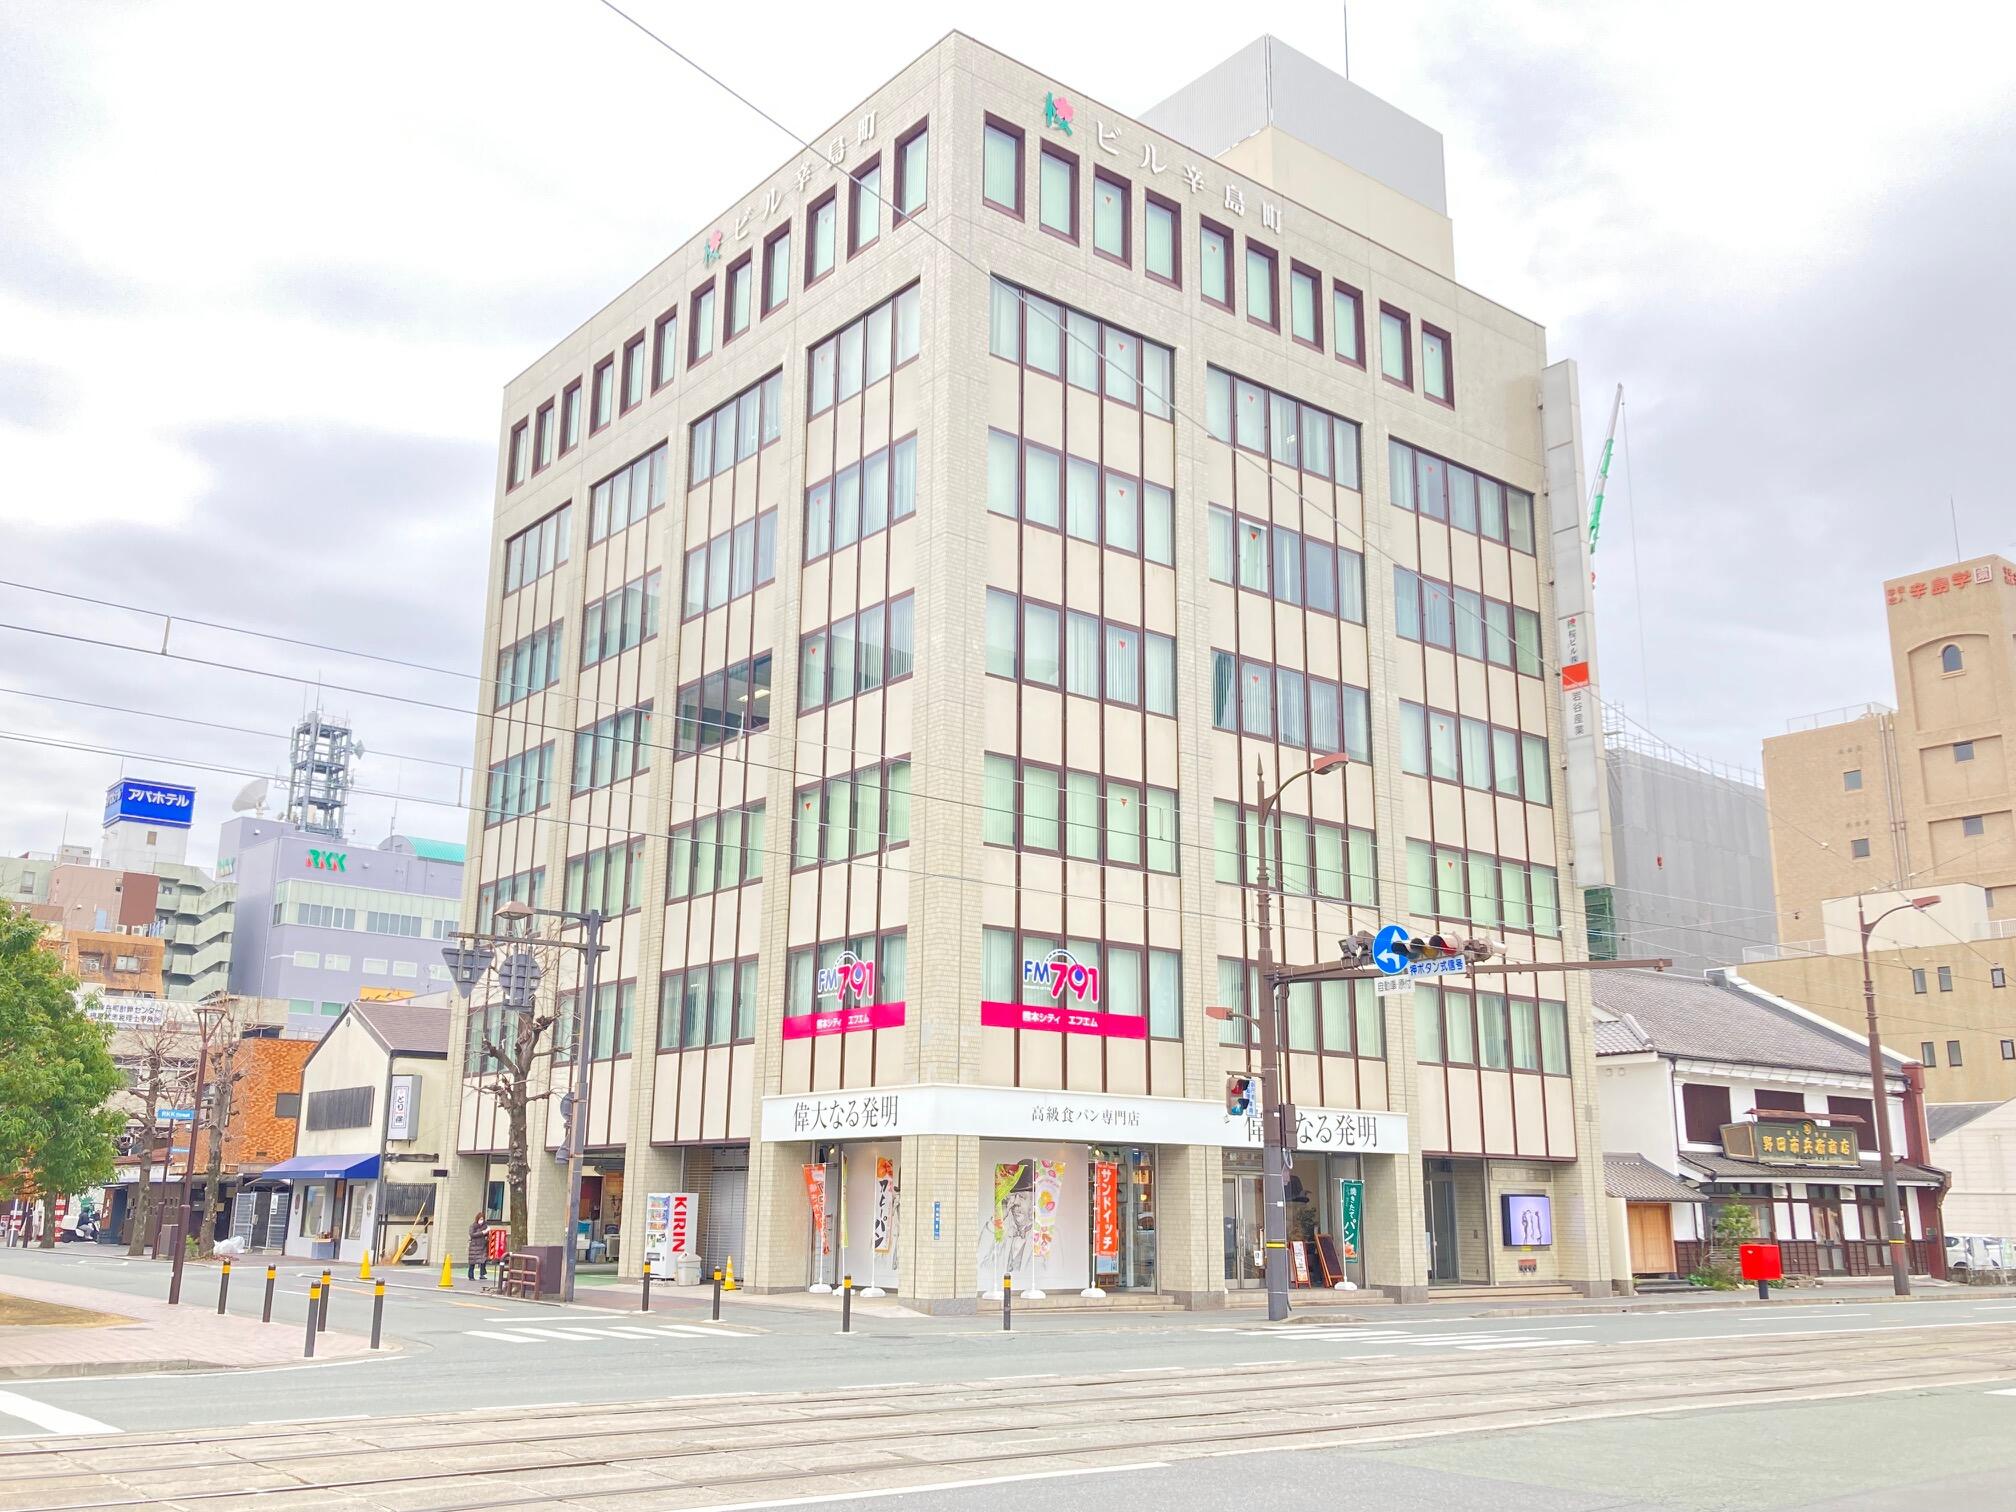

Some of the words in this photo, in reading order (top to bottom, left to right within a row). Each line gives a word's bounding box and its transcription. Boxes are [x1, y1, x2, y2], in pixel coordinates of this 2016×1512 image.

[127, 788, 190, 808] アパホテル
[305, 848, 347, 873] RKK
[1409, 958, 1464, 976] 押ボタン式信号
[848, 1013, 870, 1026] エフエム
[1022, 1010, 1060, 1025] 熊本シティ
[1068, 1015, 1099, 1028] エフエム
[793, 1095, 899, 1133] 偉大なる発明
[1031, 1105, 1141, 1127] 高級食パン専門店
[1245, 1111, 1378, 1148] 偉なる発明
[1101, 1168, 1114, 1251] サンドイッチ
[672, 1196, 688, 1253] KIRIN
